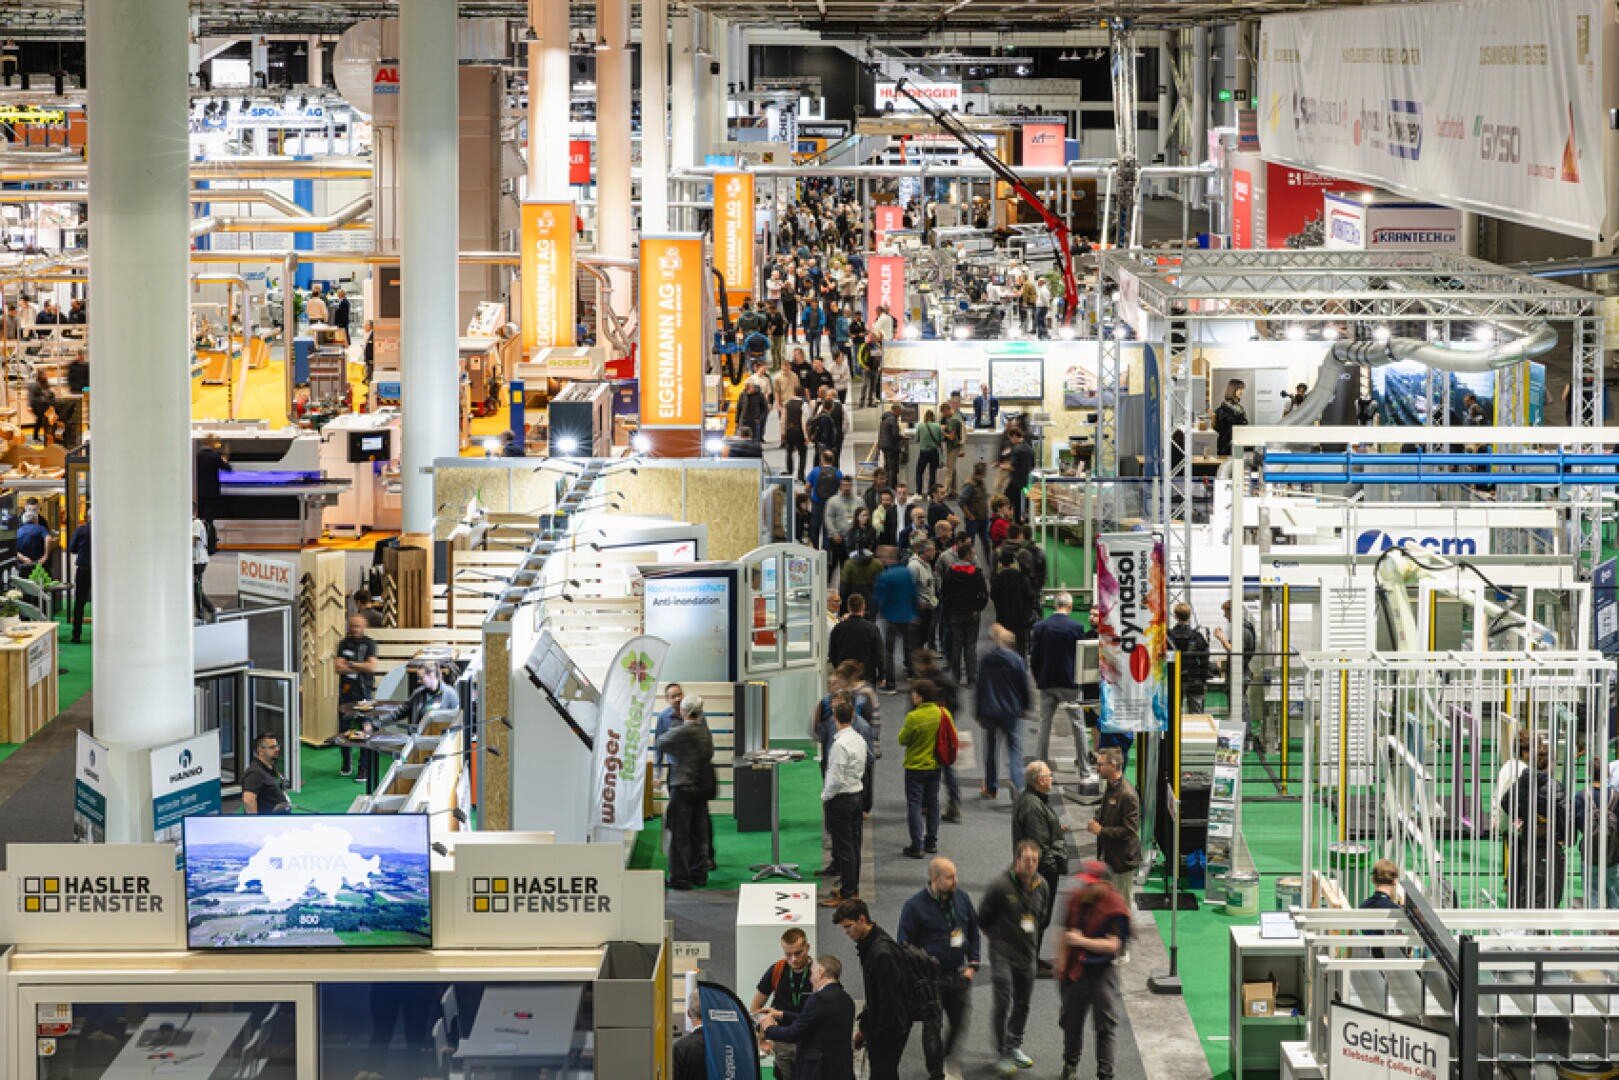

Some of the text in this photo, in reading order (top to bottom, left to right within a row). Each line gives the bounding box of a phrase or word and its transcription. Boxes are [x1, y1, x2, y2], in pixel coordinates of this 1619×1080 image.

[536, 239, 550, 261] AG
[658, 282, 675, 418] EIGENMANN AG
[241, 560, 289, 584] ROLLFIX
[1109, 550, 1143, 653] dynasol
[618, 694, 646, 782] fenster
[169, 765, 203, 784] HANNO
[602, 729, 623, 824] wenger
[287, 855, 348, 871] ATRYA
[64, 876, 150, 894] HASLER
[513, 876, 599, 894] HASLER
[64, 895, 163, 912] FENSTER
[513, 895, 612, 913] FENSTER
[1342, 1021, 1437, 1068] Geistlich
[1342, 1047, 1386, 1067] Klebstoffe
